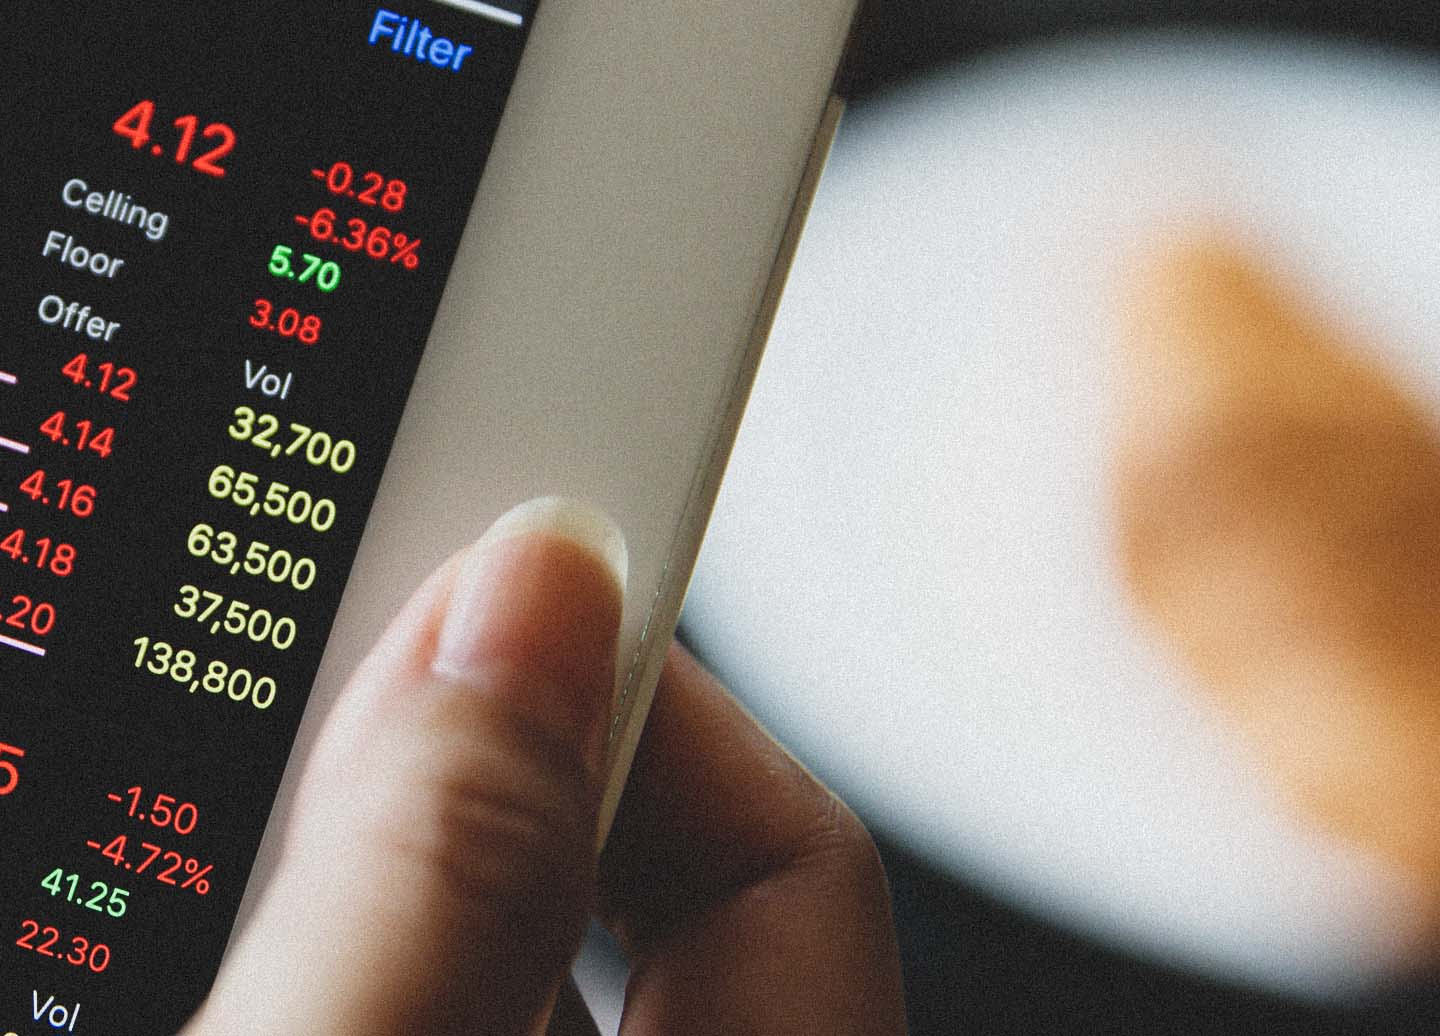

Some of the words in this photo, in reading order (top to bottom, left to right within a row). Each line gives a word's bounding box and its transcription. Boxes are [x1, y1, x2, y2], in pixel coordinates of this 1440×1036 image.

[368, 10, 472, 70] Filter
[112, 100, 236, 177] 4.12
[62, 179, 169, 241] Celling
[312, 162, 407, 212] -0.28
[42, 231, 125, 279] Floor
[295, 208, 421, 270] -6.36%
[269, 245, 341, 292] 5.70
[38, 295, 121, 342] Offer
[249, 298, 321, 344] 3.08
[62, 353, 137, 401] 4.12
[245, 360, 293, 400] Vol
[40, 411, 114, 458] 4.14
[229, 406, 355, 473] 32,700
[19, 470, 97, 518] 4.16
[208, 465, 336, 531] 65,500
[0, 528, 76, 576] 4.18
[188, 524, 316, 590] 63,500
[174, 585, 296, 649] 37,500
[133, 636, 276, 709] 138,800
[108, 786, 198, 835] -1.50
[87, 835, 213, 895] -4.72%
[41, 868, 129, 917] 41.25
[16, 920, 110, 972] 22.30
[33, 990, 81, 1032] Vol
